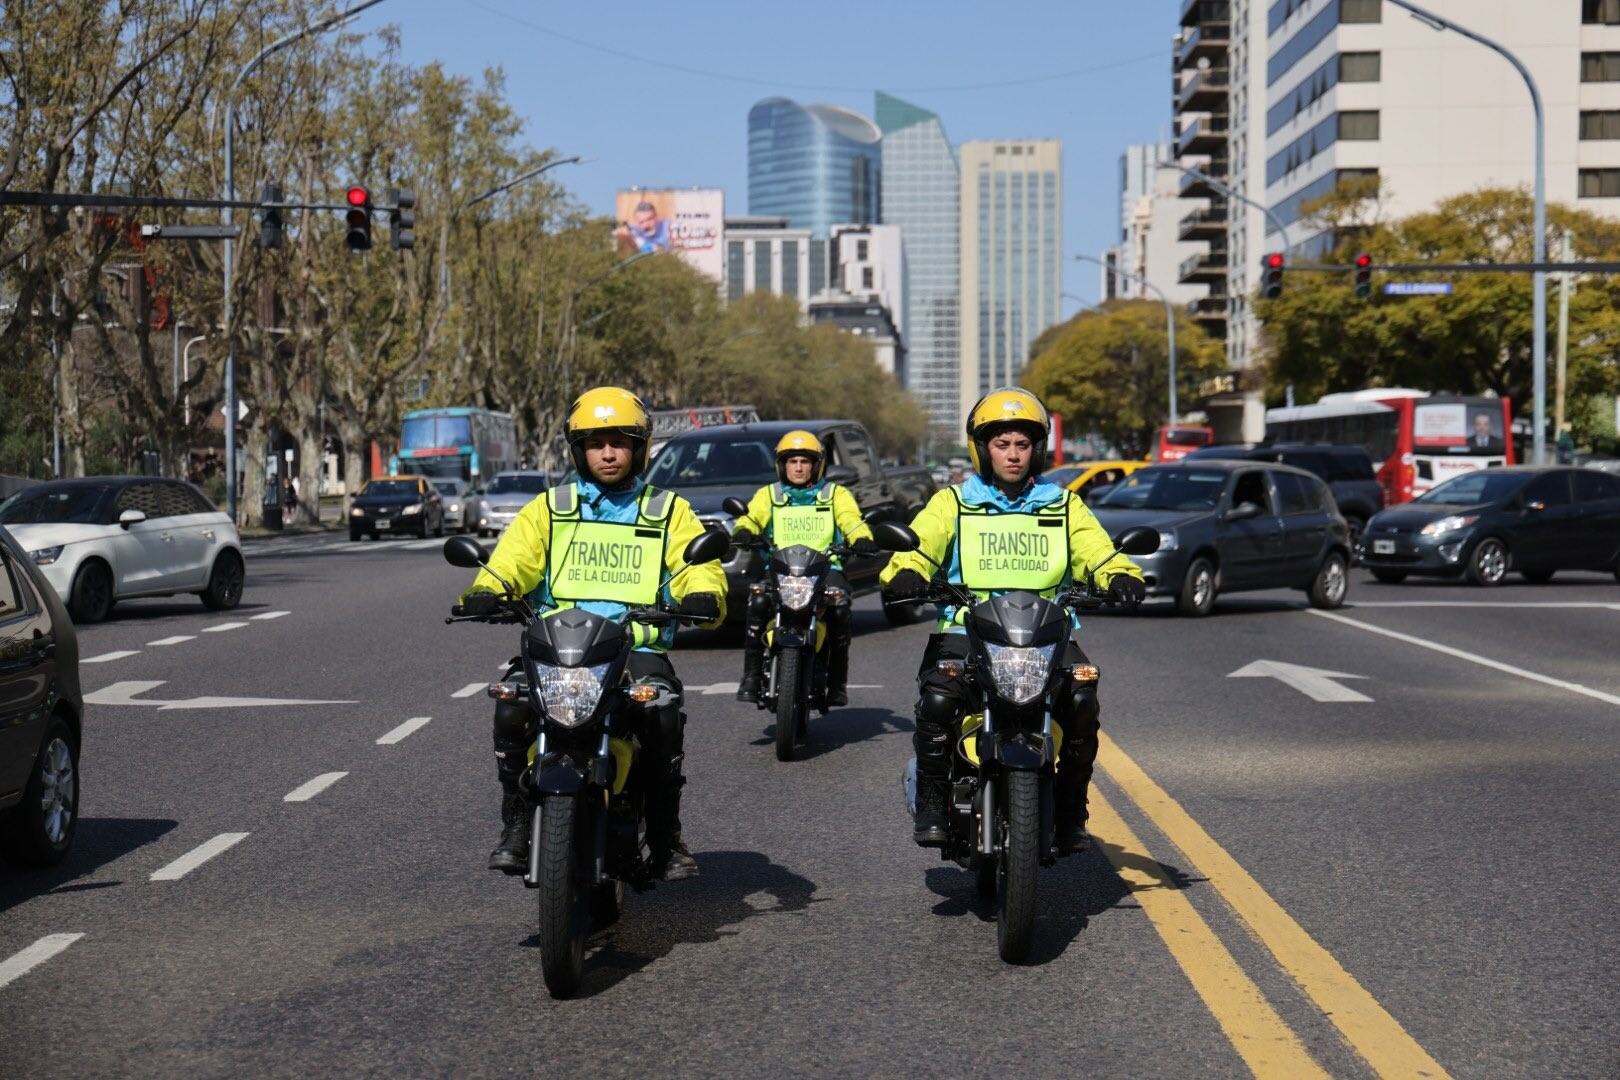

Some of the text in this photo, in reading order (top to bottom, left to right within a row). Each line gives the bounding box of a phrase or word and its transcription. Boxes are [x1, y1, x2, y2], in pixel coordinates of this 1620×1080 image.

[783, 516, 825, 533] TRANSITO
[978, 531, 1049, 558] TRANSITO
[570, 541, 643, 570] TRANSITO
[979, 558, 1049, 572] DE LA CIUDAD
[568, 568, 641, 585] DE LA CIUDAD
